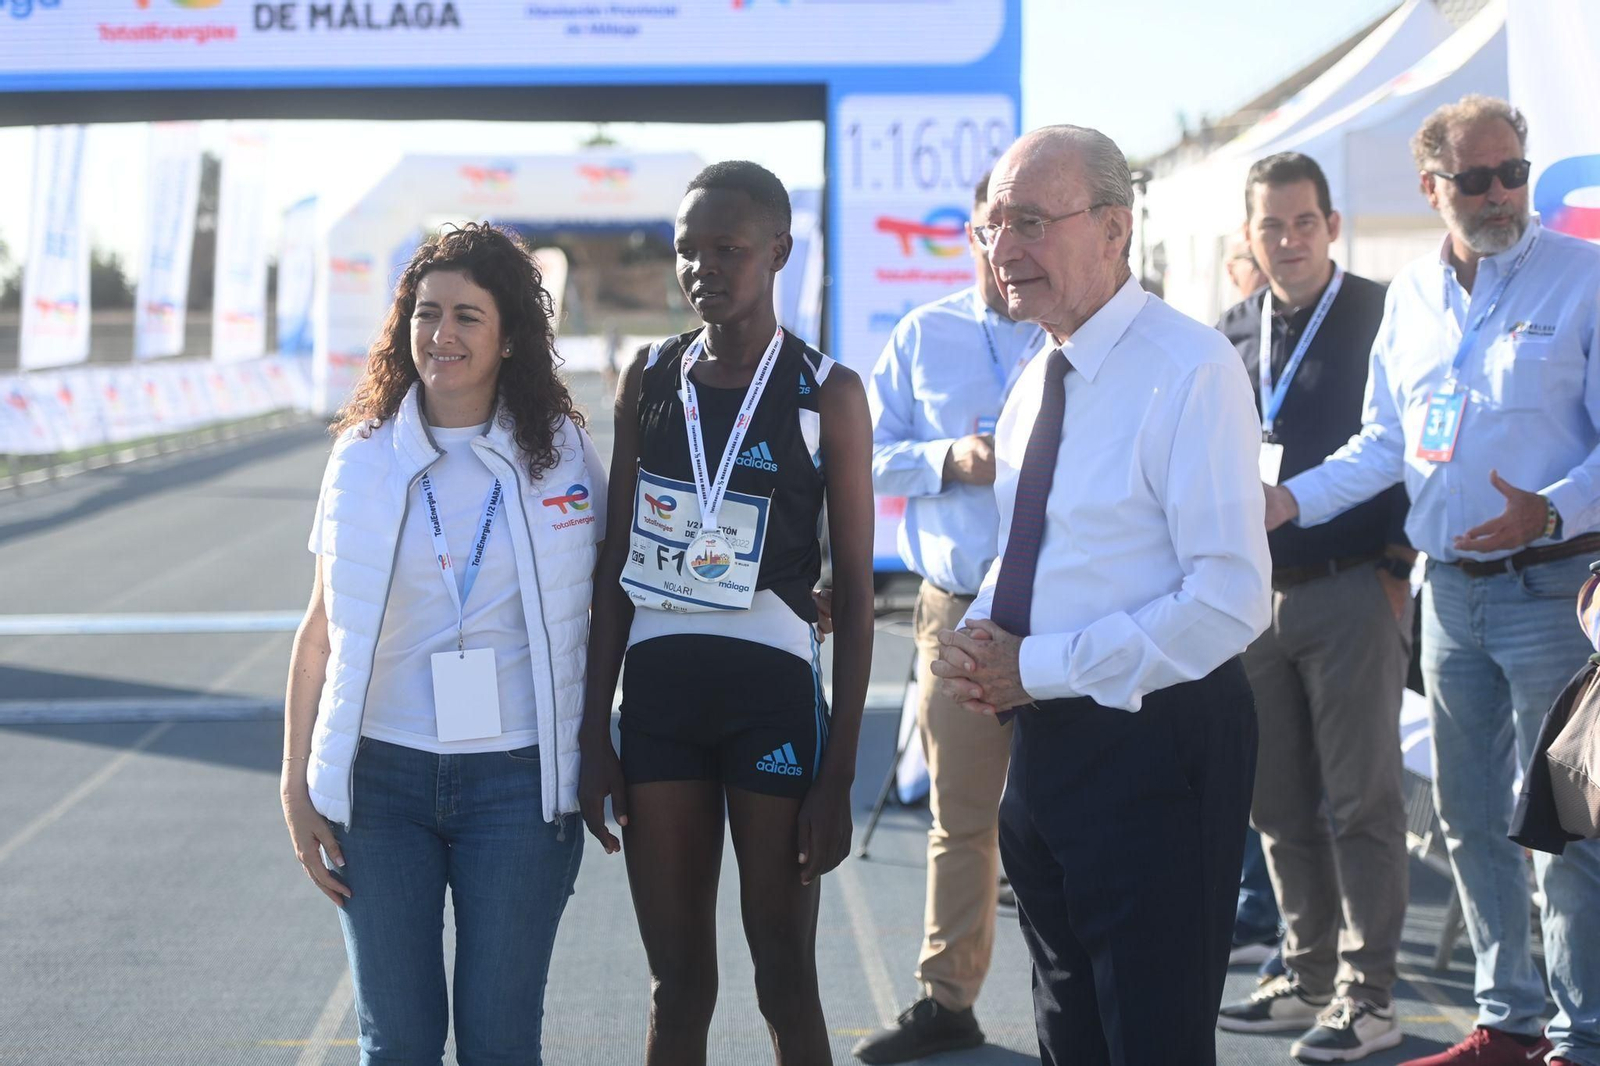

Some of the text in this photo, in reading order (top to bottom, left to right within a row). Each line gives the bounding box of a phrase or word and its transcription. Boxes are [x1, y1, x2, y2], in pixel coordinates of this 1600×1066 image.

[253, 3, 297, 31] DE
[97, 23, 237, 43] TotalEnergies
[735, 455, 778, 472] adidas
[427, 491, 441, 537] TotalEnergies
[552, 515, 596, 531] TotalEnergies
[643, 516, 674, 533] TotalEnergies
[686, 520, 699, 529] 1/2
[472, 518, 492, 567] TotalEnergies
[486, 505, 496, 518] 1/2
[685, 530, 696, 539] DE
[731, 538, 750, 548] 2022
[663, 580, 693, 596] NOLARI
[718, 580, 750, 593] málaga
[756, 760, 803, 776] adidas
